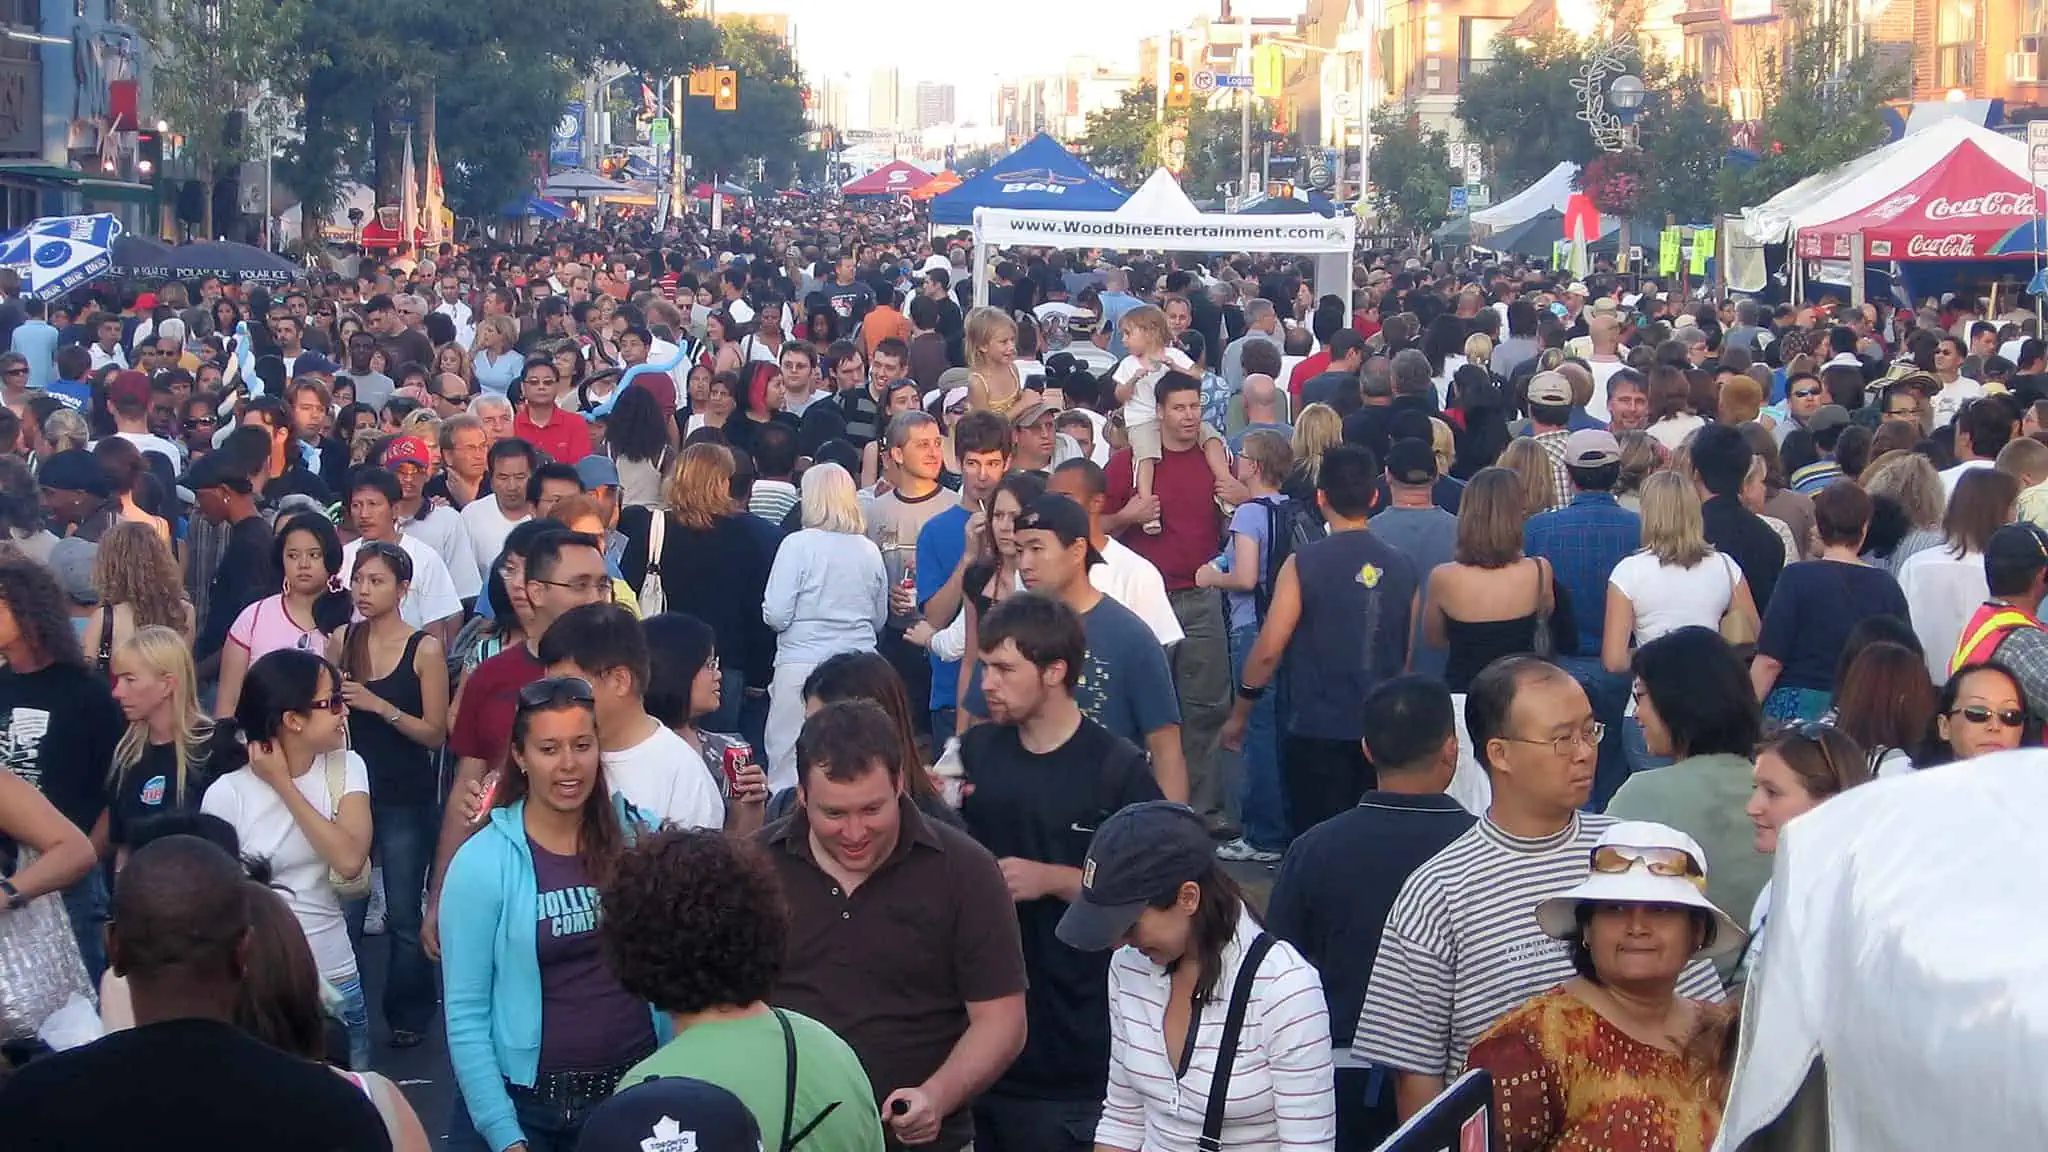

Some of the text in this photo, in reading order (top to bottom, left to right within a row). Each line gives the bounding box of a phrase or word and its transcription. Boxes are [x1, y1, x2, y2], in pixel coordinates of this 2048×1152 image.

[1010, 218, 1325, 240] www.WoodbineEntertainment.com
[240, 269, 269, 279] POLAR
[271, 270, 289, 280] ICE
